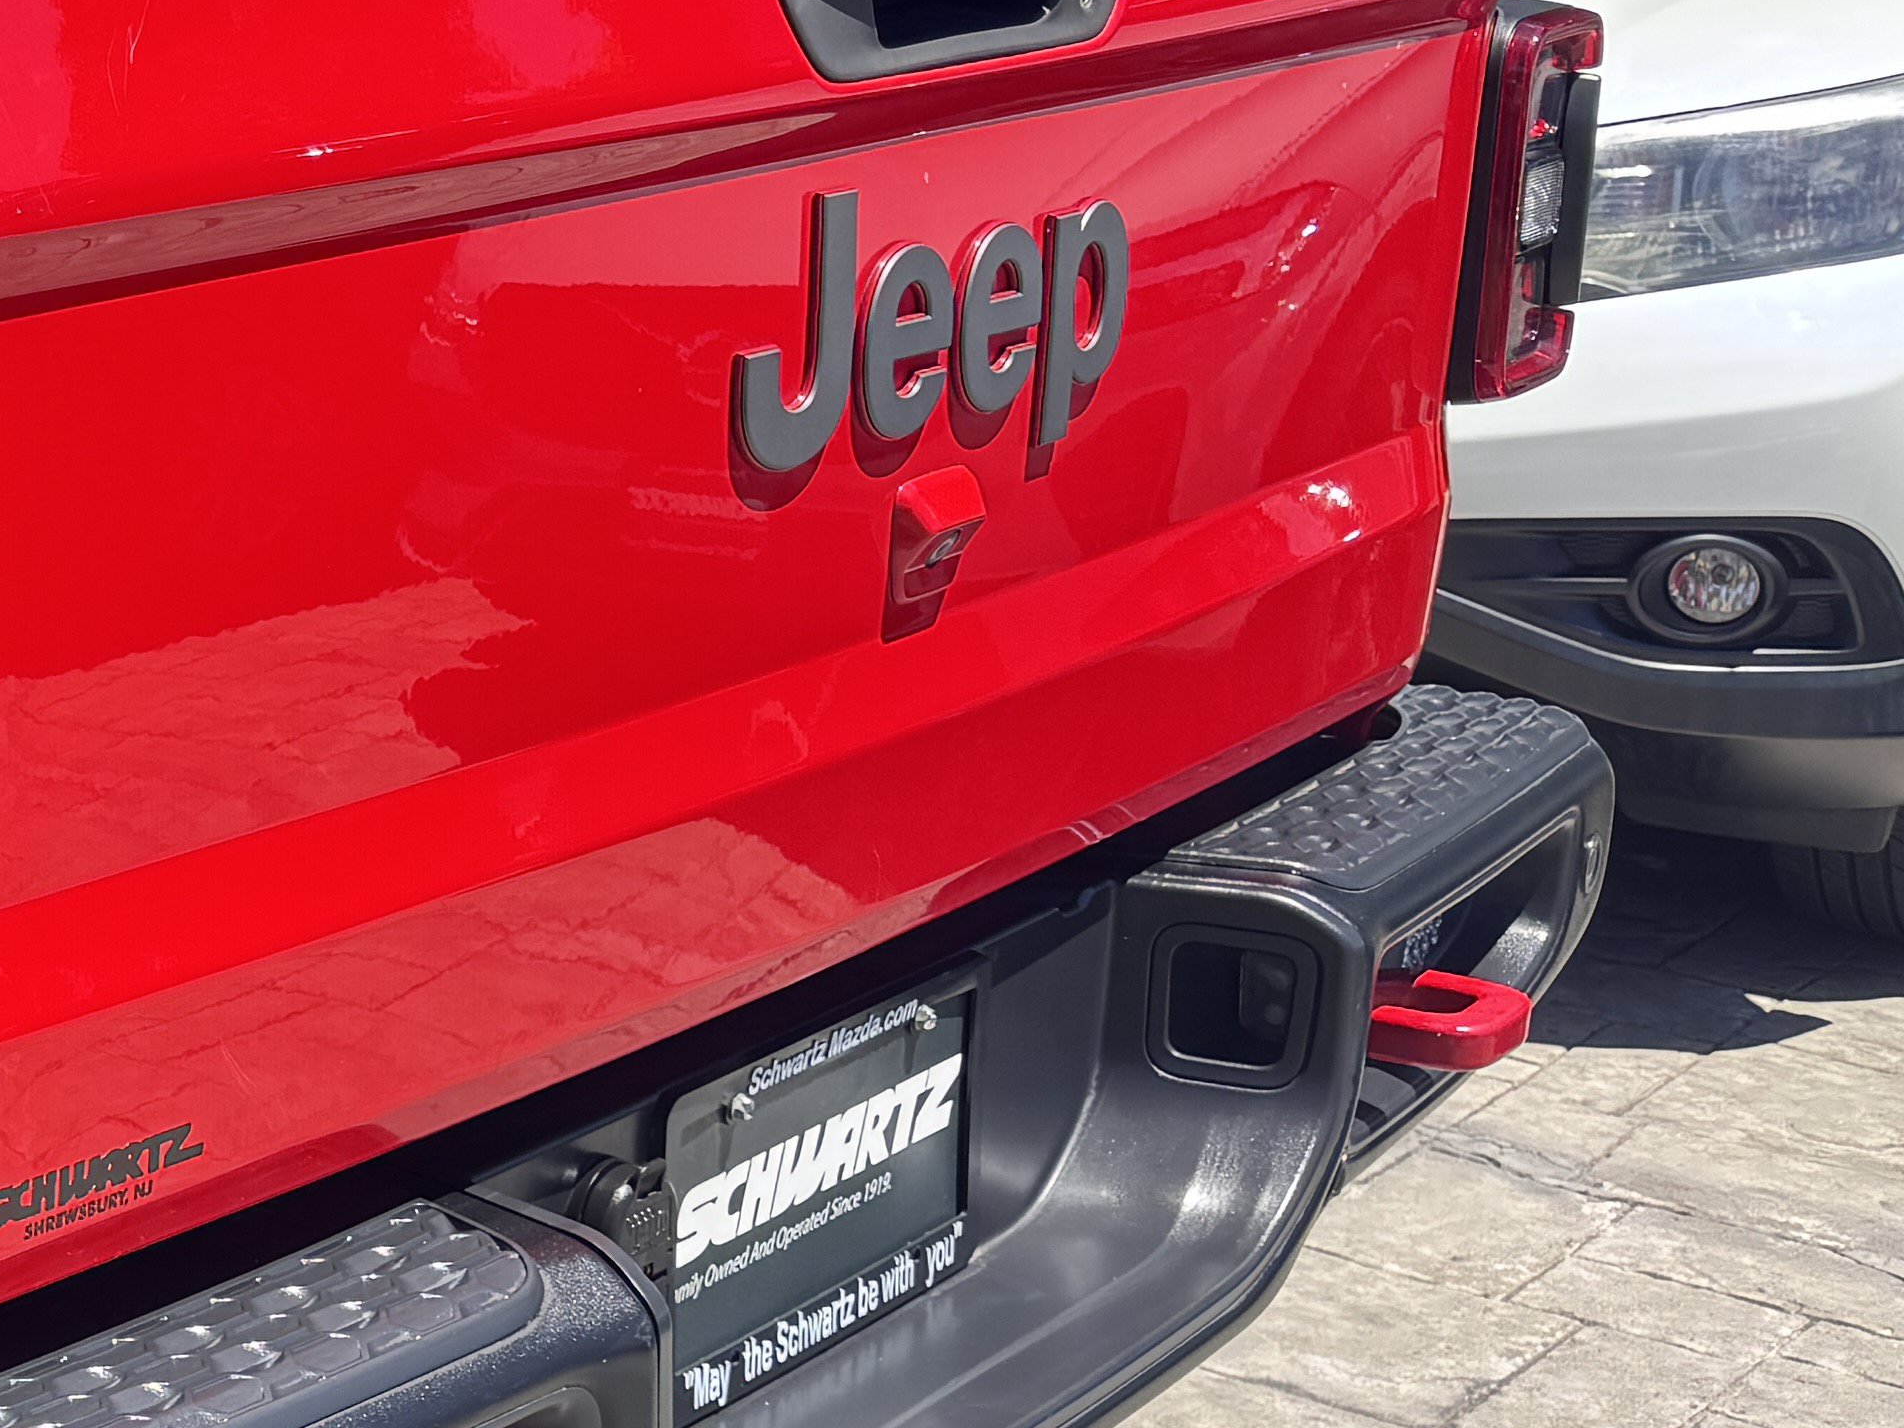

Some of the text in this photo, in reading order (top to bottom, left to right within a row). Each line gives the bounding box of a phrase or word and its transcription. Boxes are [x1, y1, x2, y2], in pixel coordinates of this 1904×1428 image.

[732, 188, 1129, 470] Jeep
[748, 1040, 830, 1096] Schwartz
[23, 1179, 153, 1240] SHREWSBURY, NJ
[675, 1053, 963, 1269] SCHWARTZ
[704, 1244, 751, 1287] Owned
[749, 1231, 777, 1264] And
[776, 1201, 831, 1251] Operated
[829, 1191, 862, 1220] Since
[683, 1221, 963, 1410] "May the Schwartz be with you"
